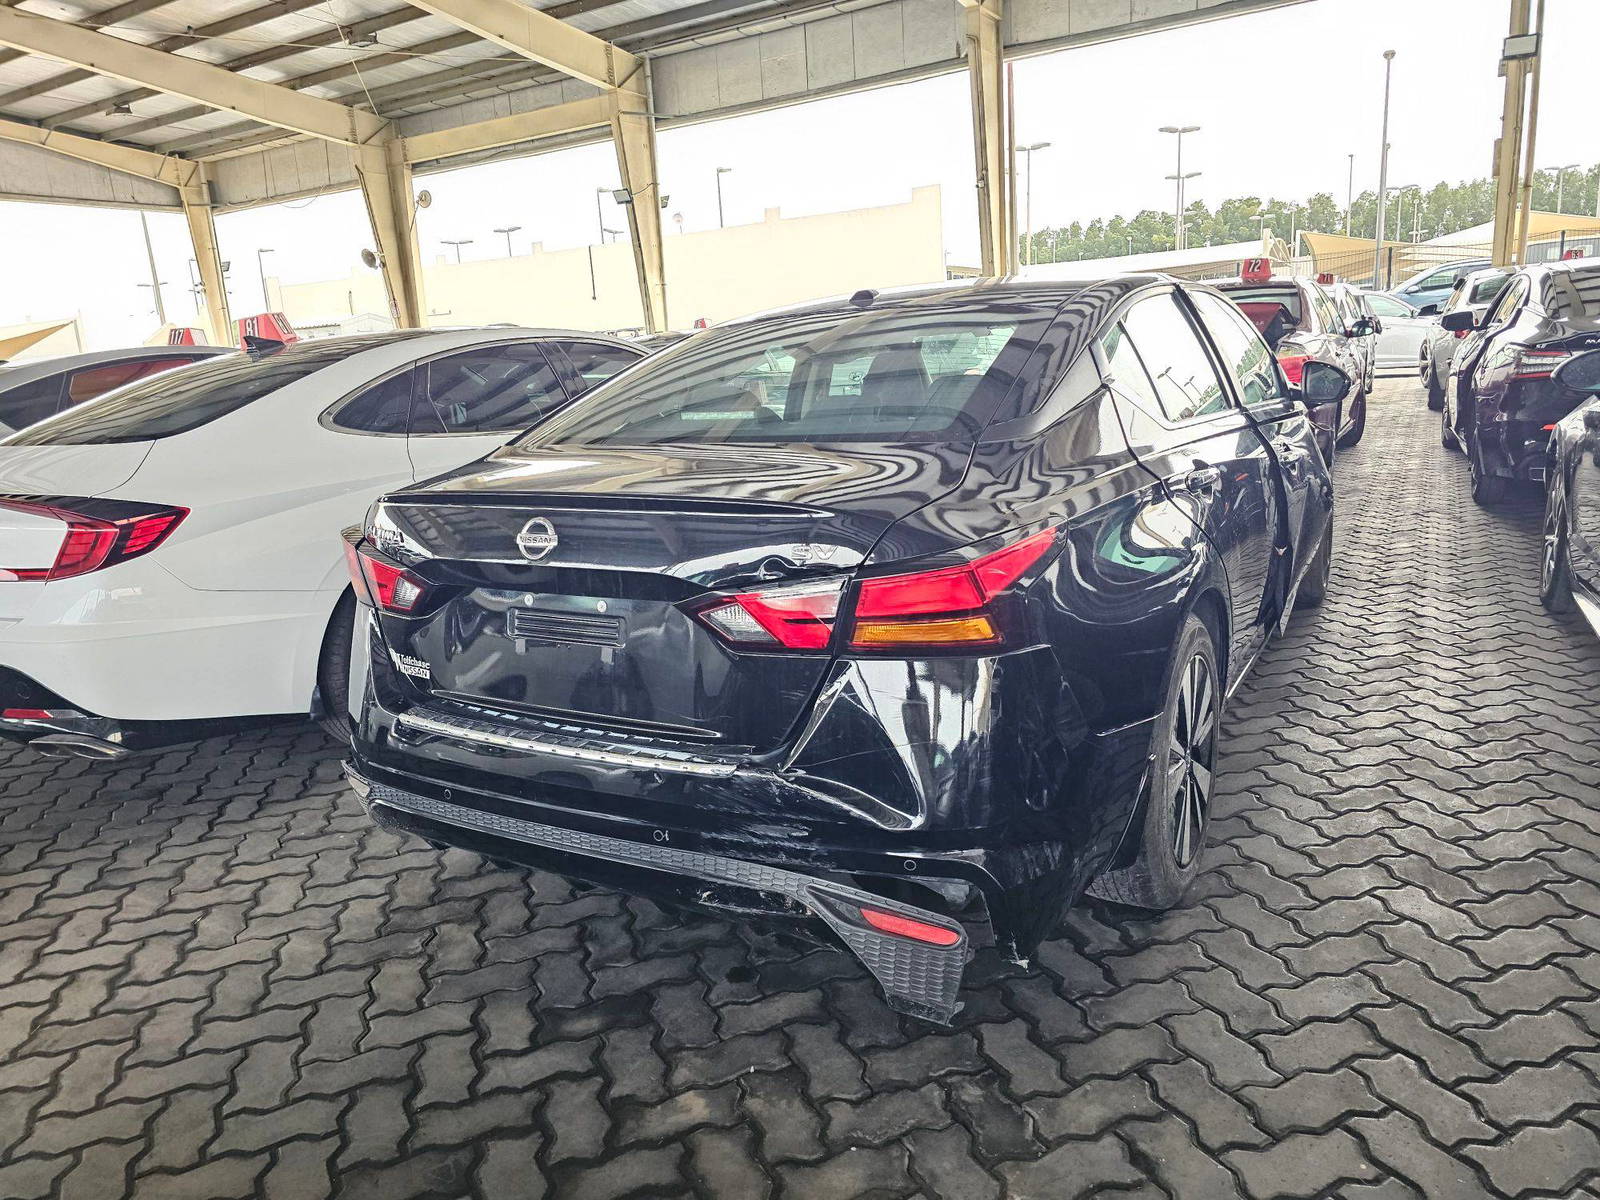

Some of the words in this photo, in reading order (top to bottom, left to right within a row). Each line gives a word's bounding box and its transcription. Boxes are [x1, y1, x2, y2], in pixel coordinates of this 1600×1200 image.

[1249, 260, 1261, 272] 72
[246, 317, 258, 336] 81
[170, 329, 183, 345] 117
[520, 535, 553, 544] NISSAN
